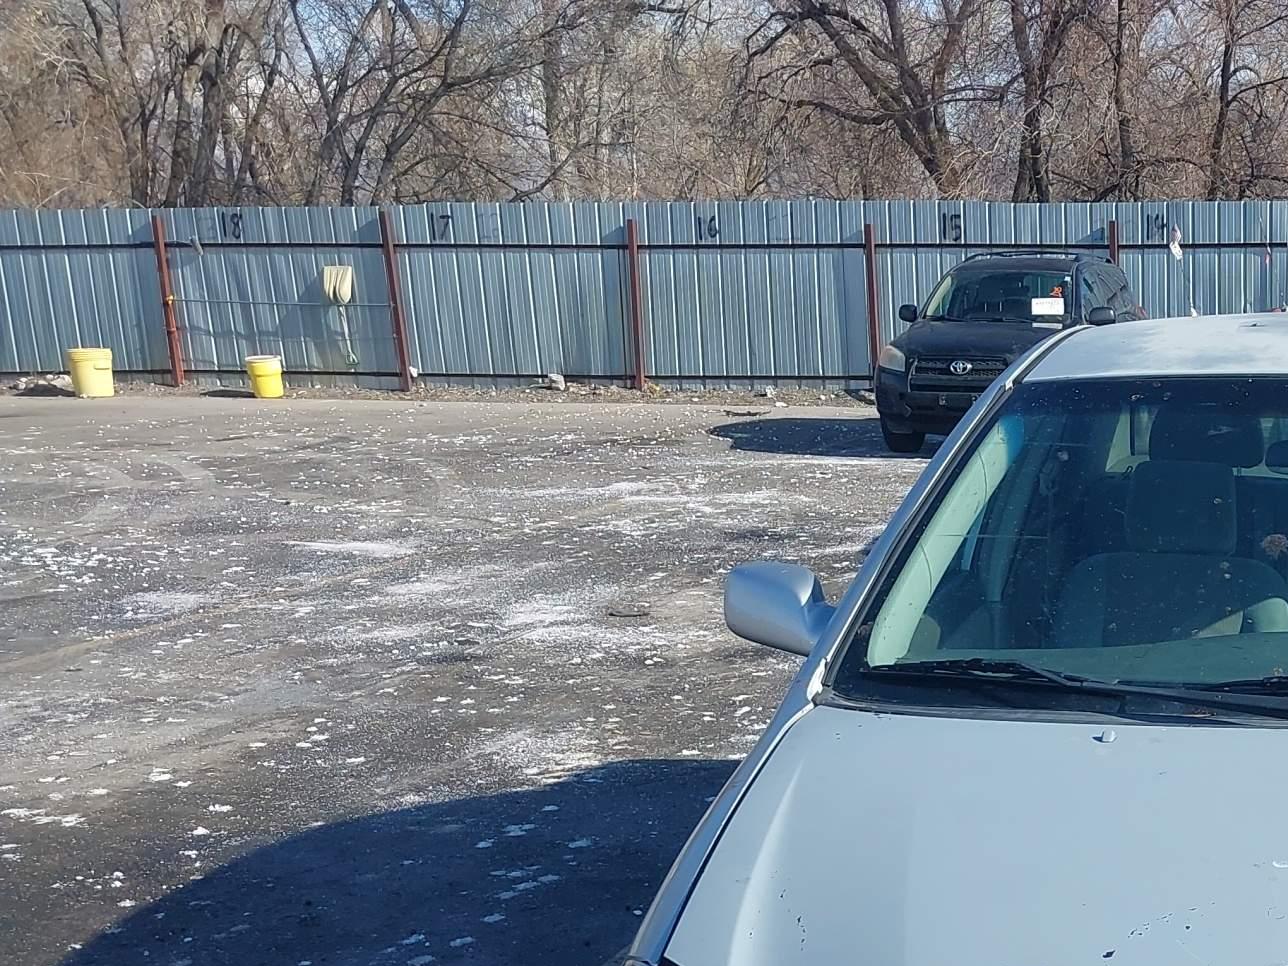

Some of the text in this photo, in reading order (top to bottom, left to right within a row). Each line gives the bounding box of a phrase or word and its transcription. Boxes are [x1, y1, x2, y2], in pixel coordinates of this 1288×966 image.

[221, 211, 242, 240] 18
[430, 212, 452, 241] 17
[697, 215, 719, 241] 16
[942, 212, 962, 242] 15
[1146, 213, 1167, 241] 14
